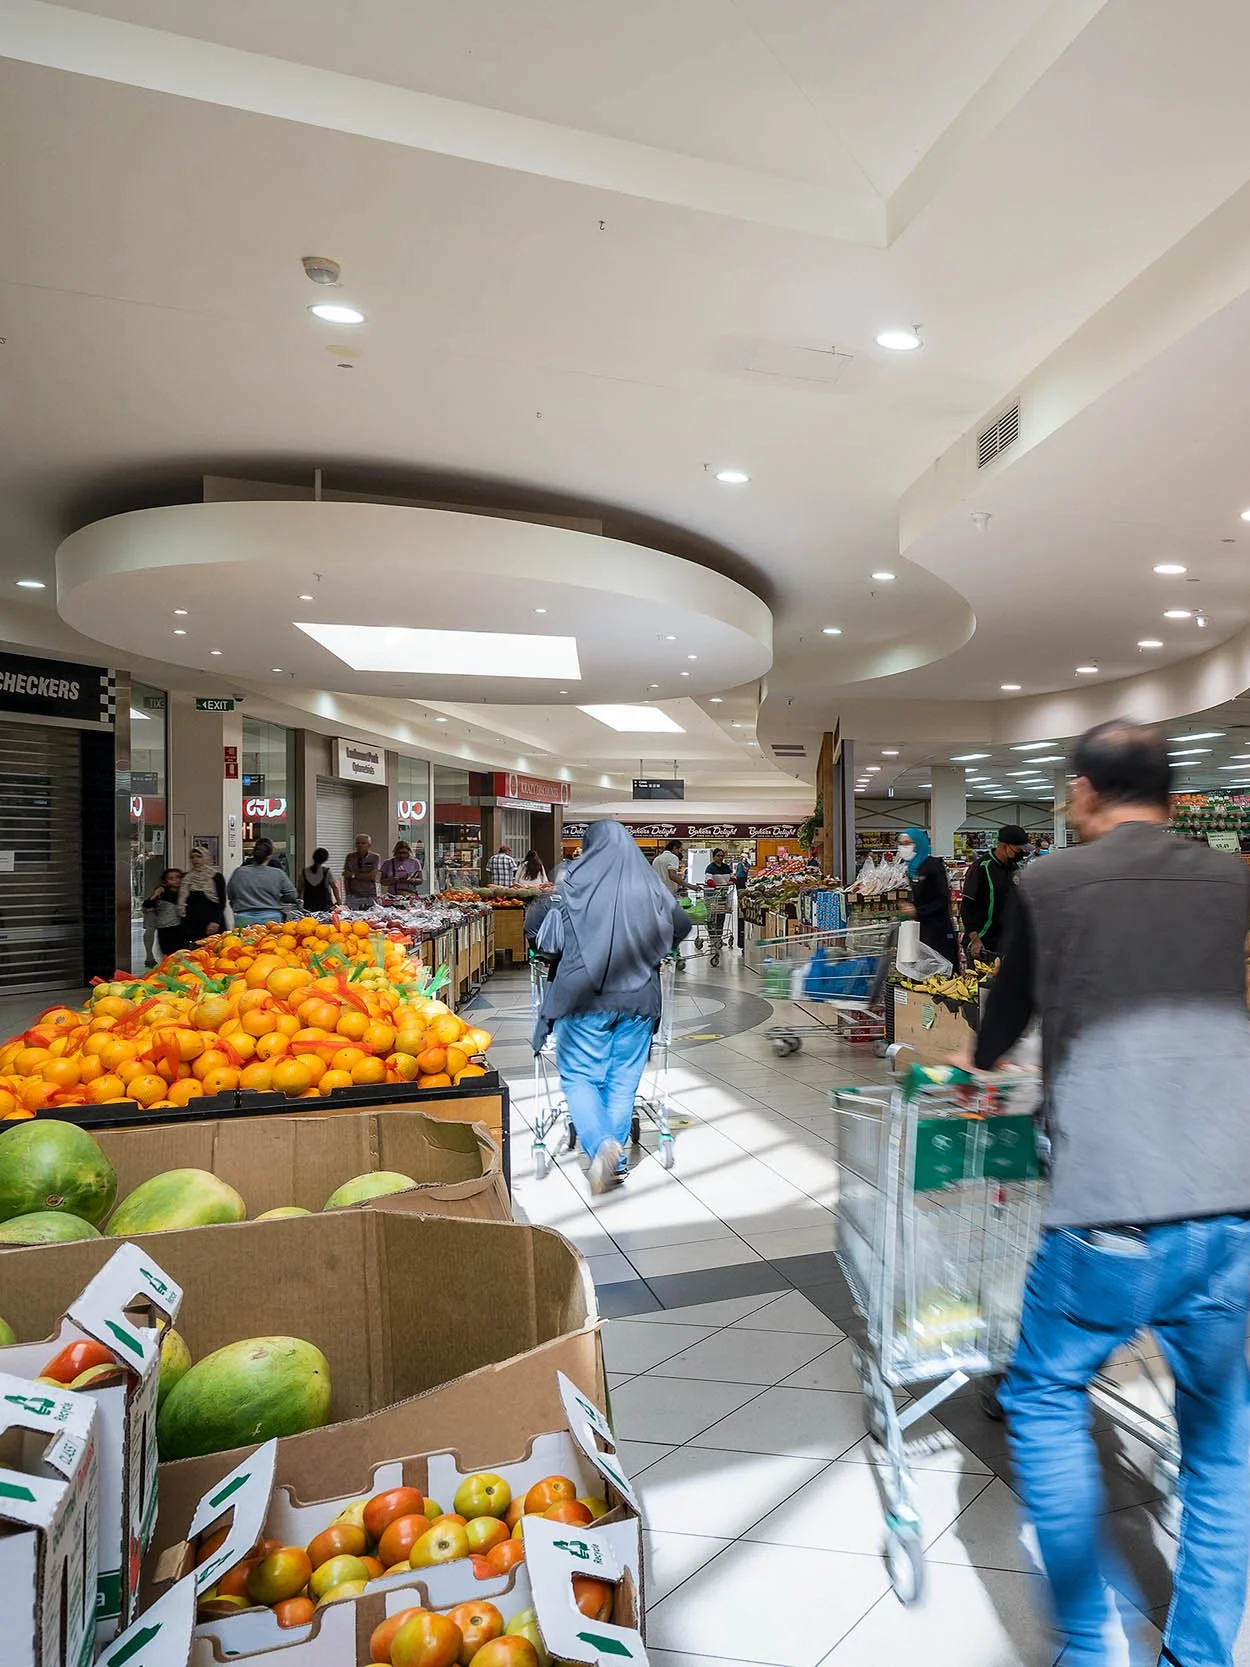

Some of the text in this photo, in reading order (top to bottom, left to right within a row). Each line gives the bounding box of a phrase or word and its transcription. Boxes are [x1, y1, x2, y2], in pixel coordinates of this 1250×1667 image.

[207, 700, 228, 710] EXIT
[651, 826, 677, 838] Delight
[712, 826, 738, 838] Delight
[772, 826, 797, 838] Delight
